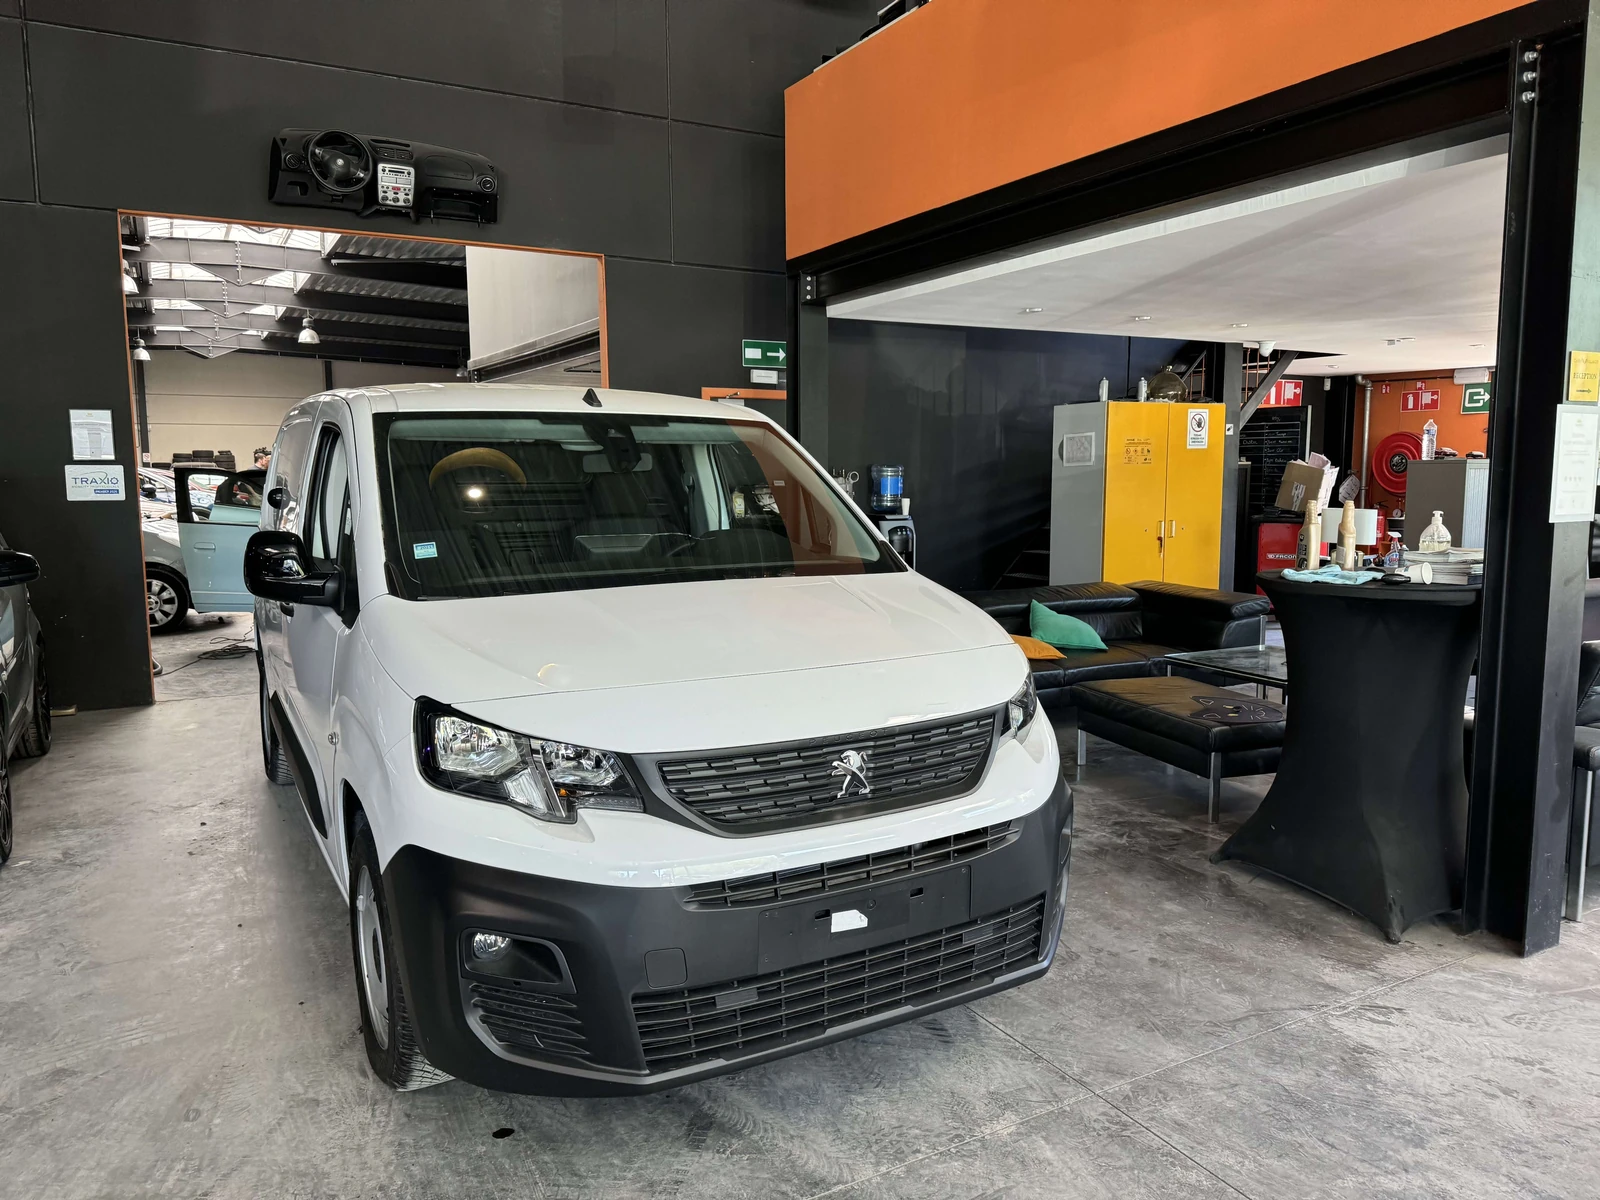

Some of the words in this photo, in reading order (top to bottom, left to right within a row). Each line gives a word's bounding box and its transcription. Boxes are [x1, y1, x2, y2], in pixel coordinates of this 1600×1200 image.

[1573, 372, 1597, 380] RECEPTION
[71, 476, 119, 485] TRAXIO
[808, 729, 888, 746] PEUGEOT
